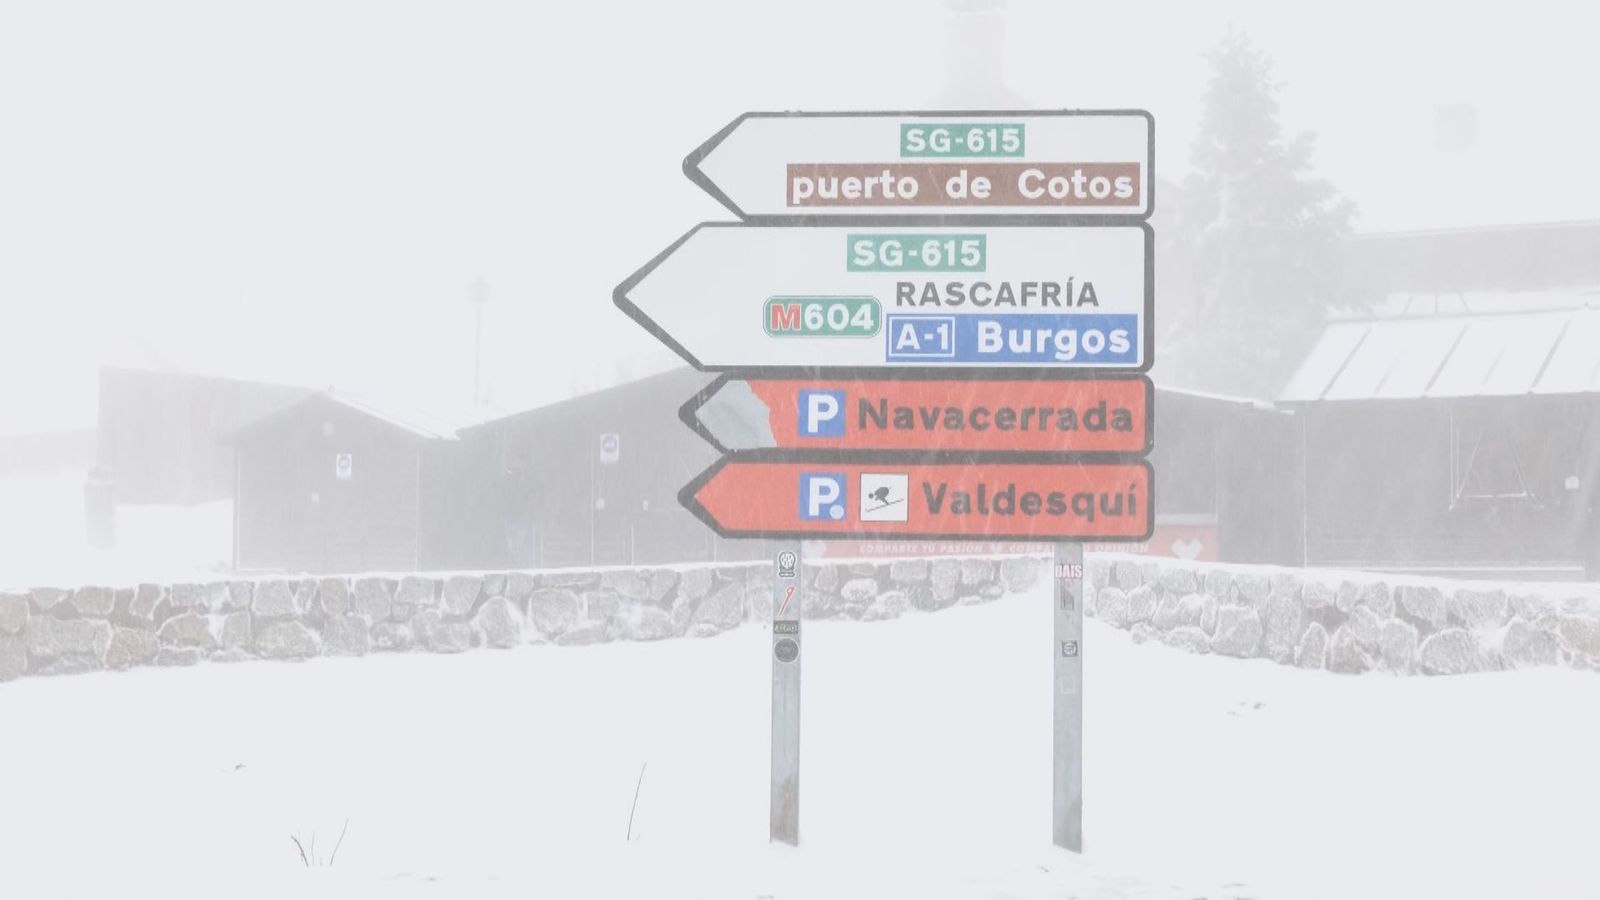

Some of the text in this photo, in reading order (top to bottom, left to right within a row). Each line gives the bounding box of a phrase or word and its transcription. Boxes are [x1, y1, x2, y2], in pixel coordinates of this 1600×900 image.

[906, 128, 1020, 153] SG-615
[792, 169, 1134, 205] puerto de Cotos
[853, 240, 982, 267] SG-615
[896, 276, 1100, 307] RASCAFRÍA
[769, 303, 875, 332] M604
[896, 321, 1131, 361] A-1 Burgos
[807, 394, 1134, 433] P Navacerrada
[922, 482, 1137, 522] Valdesquí
